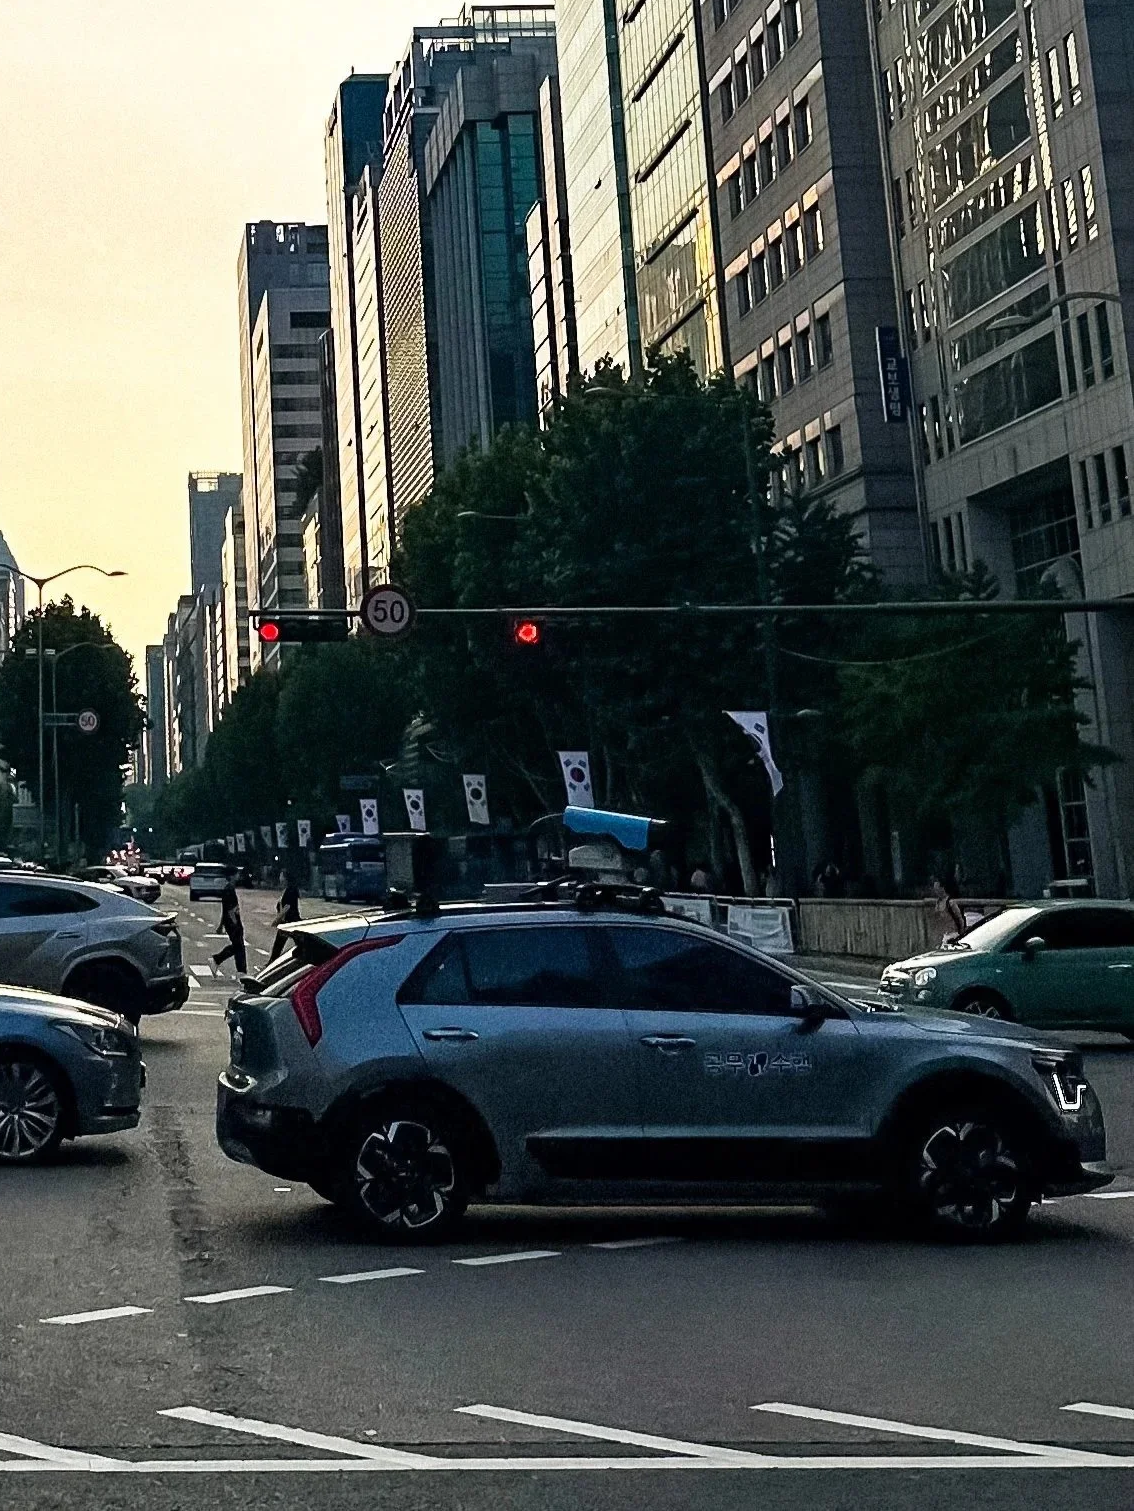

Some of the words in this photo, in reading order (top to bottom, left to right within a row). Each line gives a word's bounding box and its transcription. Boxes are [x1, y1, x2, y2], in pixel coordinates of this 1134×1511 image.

[885, 356, 902, 418] 교보생명
[372, 599, 406, 624] 50
[705, 1051, 745, 1076] 공무
[770, 1052, 813, 1074] 수행
